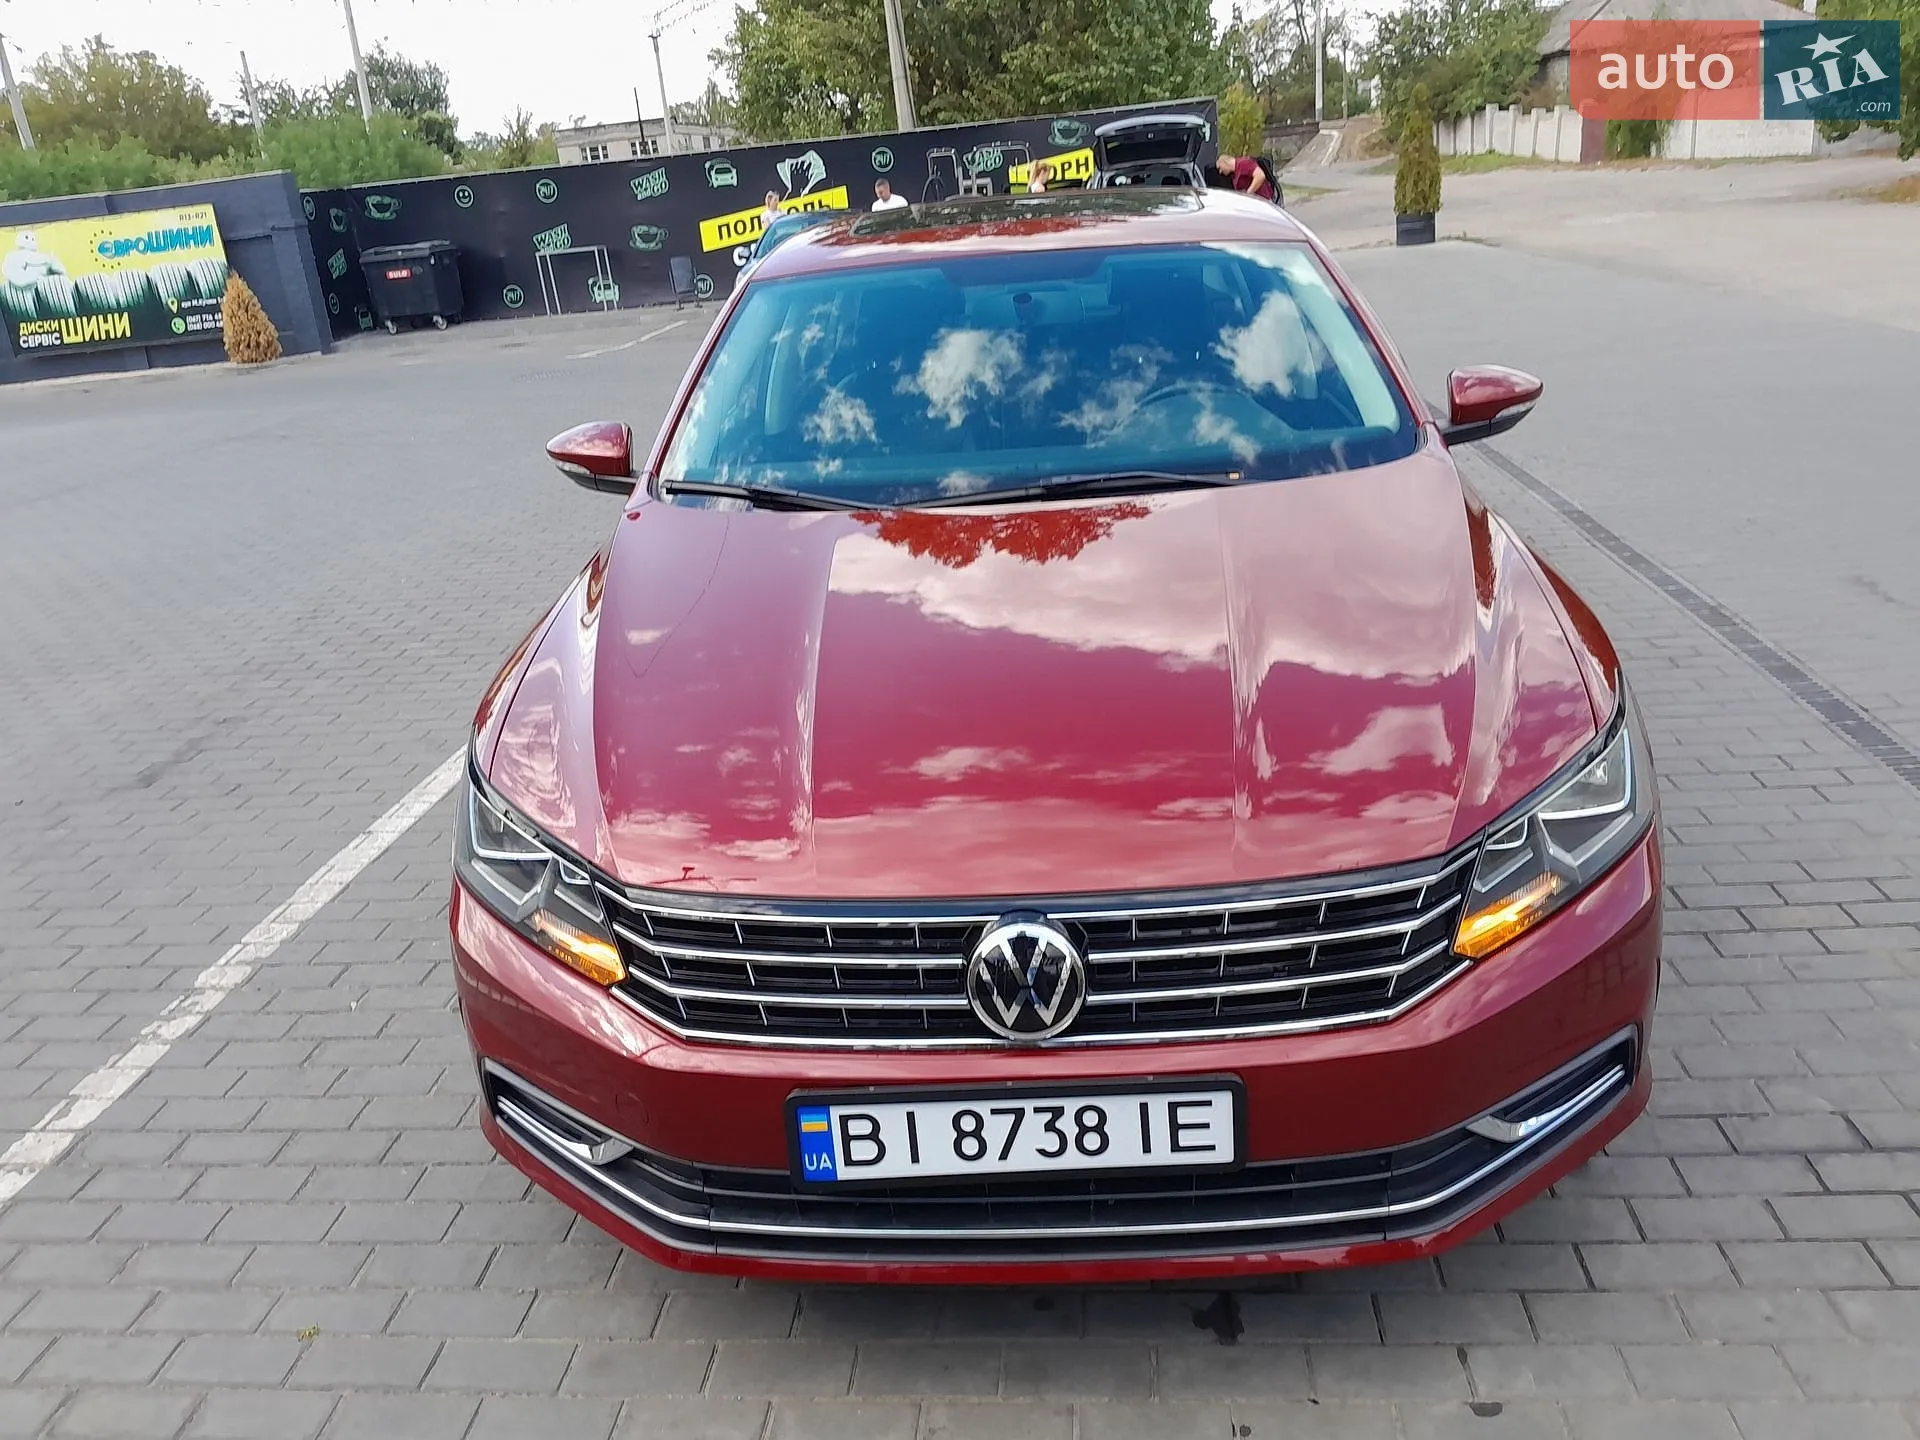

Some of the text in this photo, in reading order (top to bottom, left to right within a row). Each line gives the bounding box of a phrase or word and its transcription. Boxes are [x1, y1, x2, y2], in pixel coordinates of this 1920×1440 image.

[97, 224, 214, 259] ЄВРОШИНИ
[19, 312, 131, 344] ДИСКИ ШИНИ
[19, 332, 61, 349] СЕРВІС
[838, 1100, 1217, 1168] BI 8738 IE
[804, 1152, 833, 1172] UA
